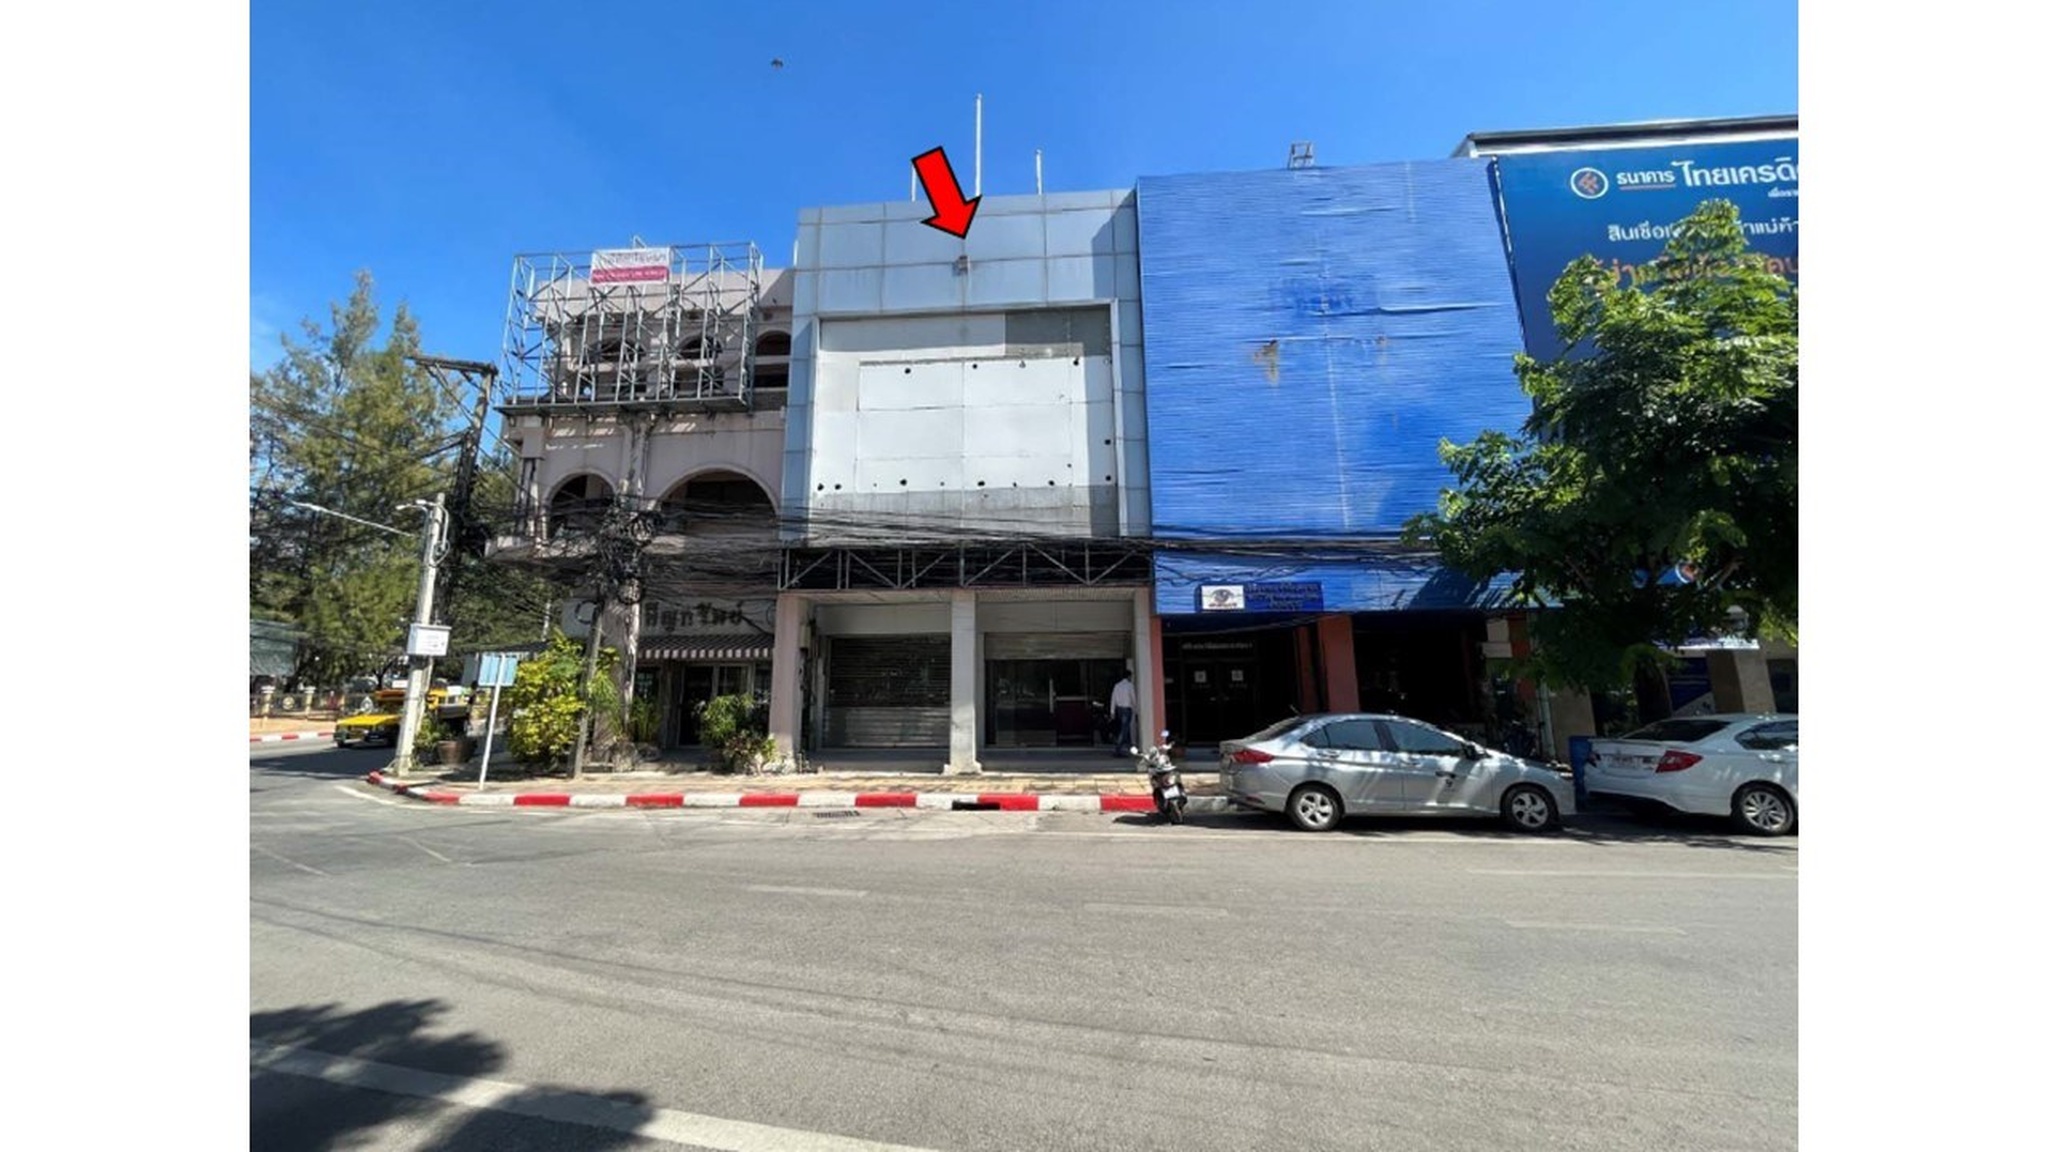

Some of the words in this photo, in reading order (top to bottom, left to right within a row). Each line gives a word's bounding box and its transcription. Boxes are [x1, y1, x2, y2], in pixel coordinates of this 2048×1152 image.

[1616, 169, 1676, 186] ธนาคาร
[1671, 157, 1798, 187] ไทยเครดิ
